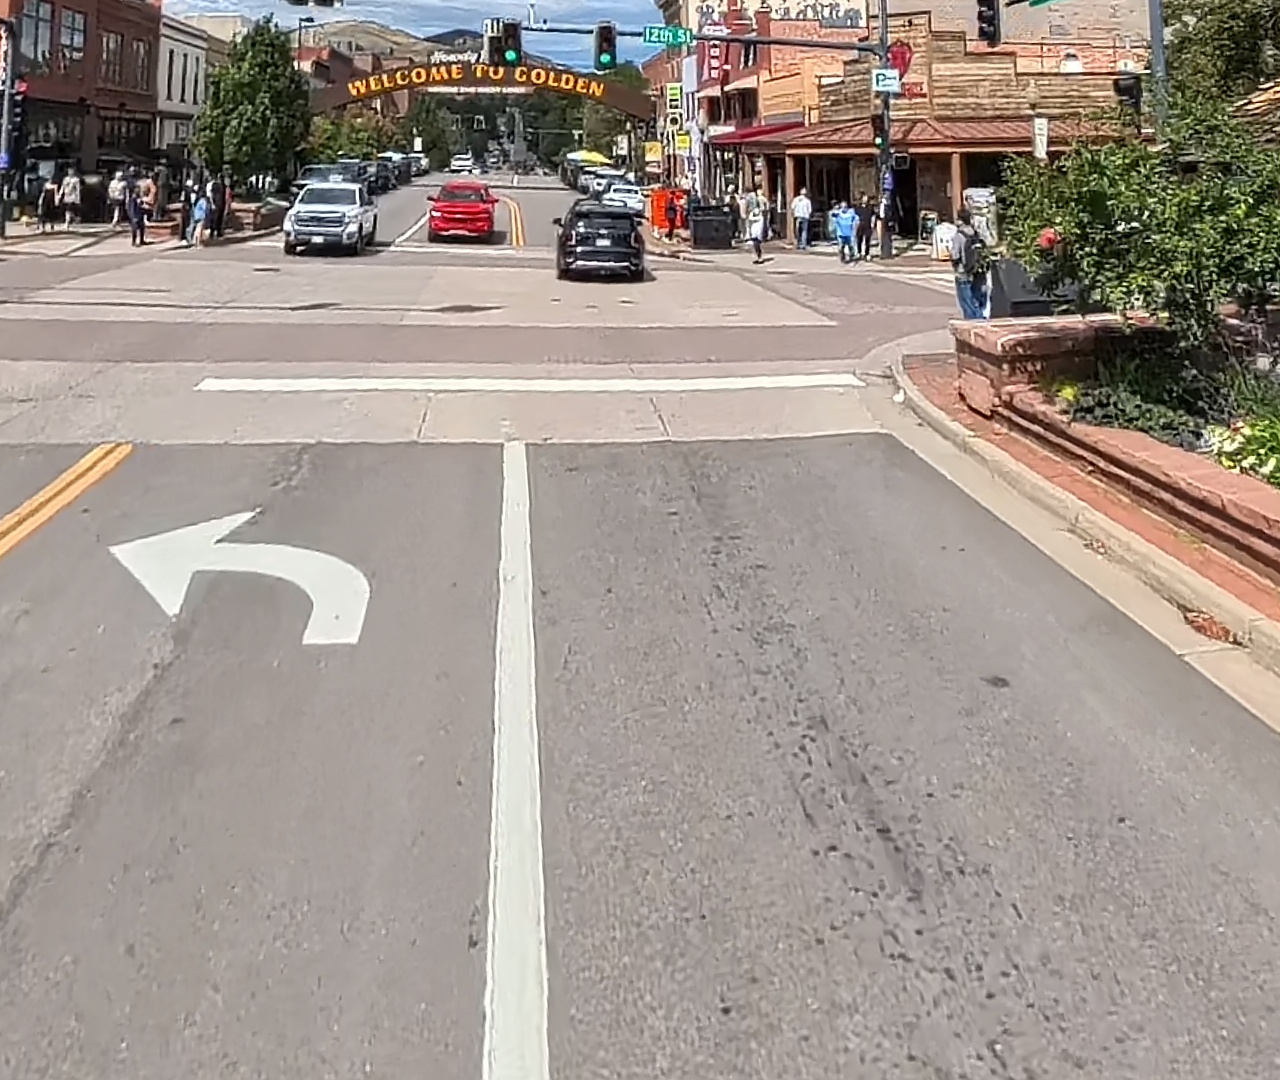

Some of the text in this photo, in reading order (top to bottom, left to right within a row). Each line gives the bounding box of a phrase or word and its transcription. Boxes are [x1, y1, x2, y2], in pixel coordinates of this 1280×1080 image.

[645, 28, 674, 41] 12th
[677, 29, 691, 41] St
[347, 63, 606, 97] WELCOME TO GOLDEN
